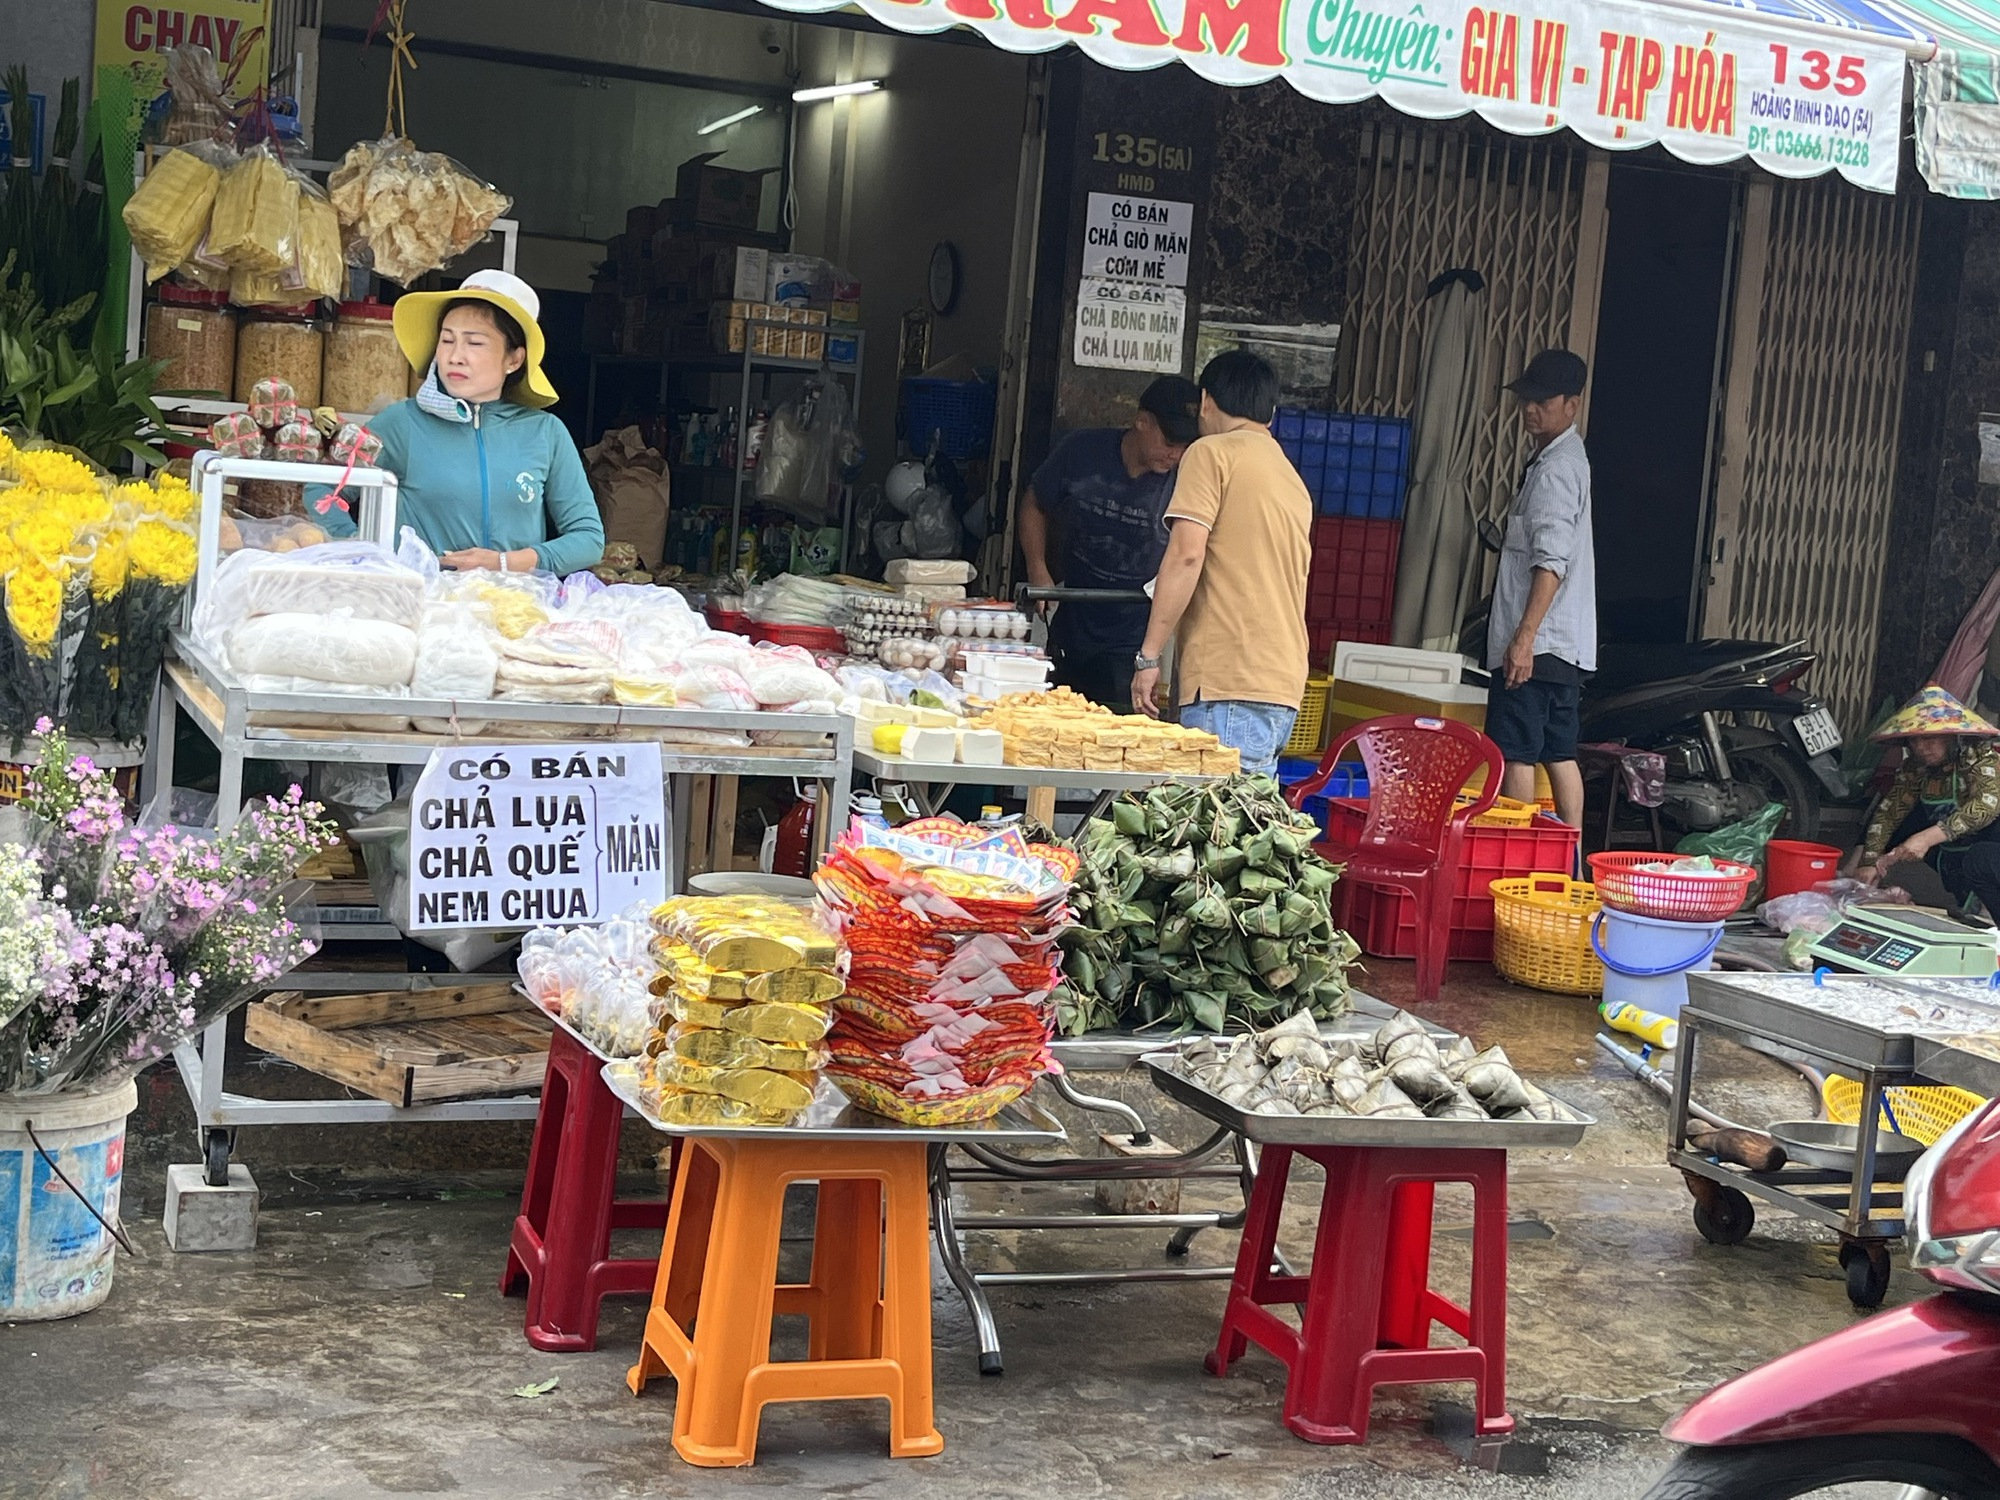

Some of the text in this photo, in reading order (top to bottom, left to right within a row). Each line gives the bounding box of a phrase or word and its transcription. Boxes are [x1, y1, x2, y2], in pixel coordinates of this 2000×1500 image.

[1307, 0, 1454, 84] Chuyên:
[1460, 6, 1520, 101] GIA
[1530, 19, 1568, 127] VỊ
[1597, 31, 1665, 139] TẠP
[1666, 31, 1738, 137] HÓA
[1769, 43, 1867, 97] 135
[1750, 87, 1873, 140] HOÀNG MINH ĐẠO (5A)
[1747, 124, 1870, 168] ĐT: 03666.13228
[1111, 199, 1169, 223] CÓ BÁN
[1088, 222, 1188, 259] CHẢ GIÒ MẶN
[1105, 255, 1138, 277] CƠM
[1111, 306, 1146, 332] BÔNG
[1082, 331, 1173, 367] CHẢ LỤA MẶN
[449, 751, 626, 781] CÓ BÁN
[420, 785, 587, 833] CHẢ LỤA
[419, 831, 586, 881] CHẢ QUẾ
[606, 814, 661, 886] MẶN
[418, 887, 588, 924] NEM CHUA
